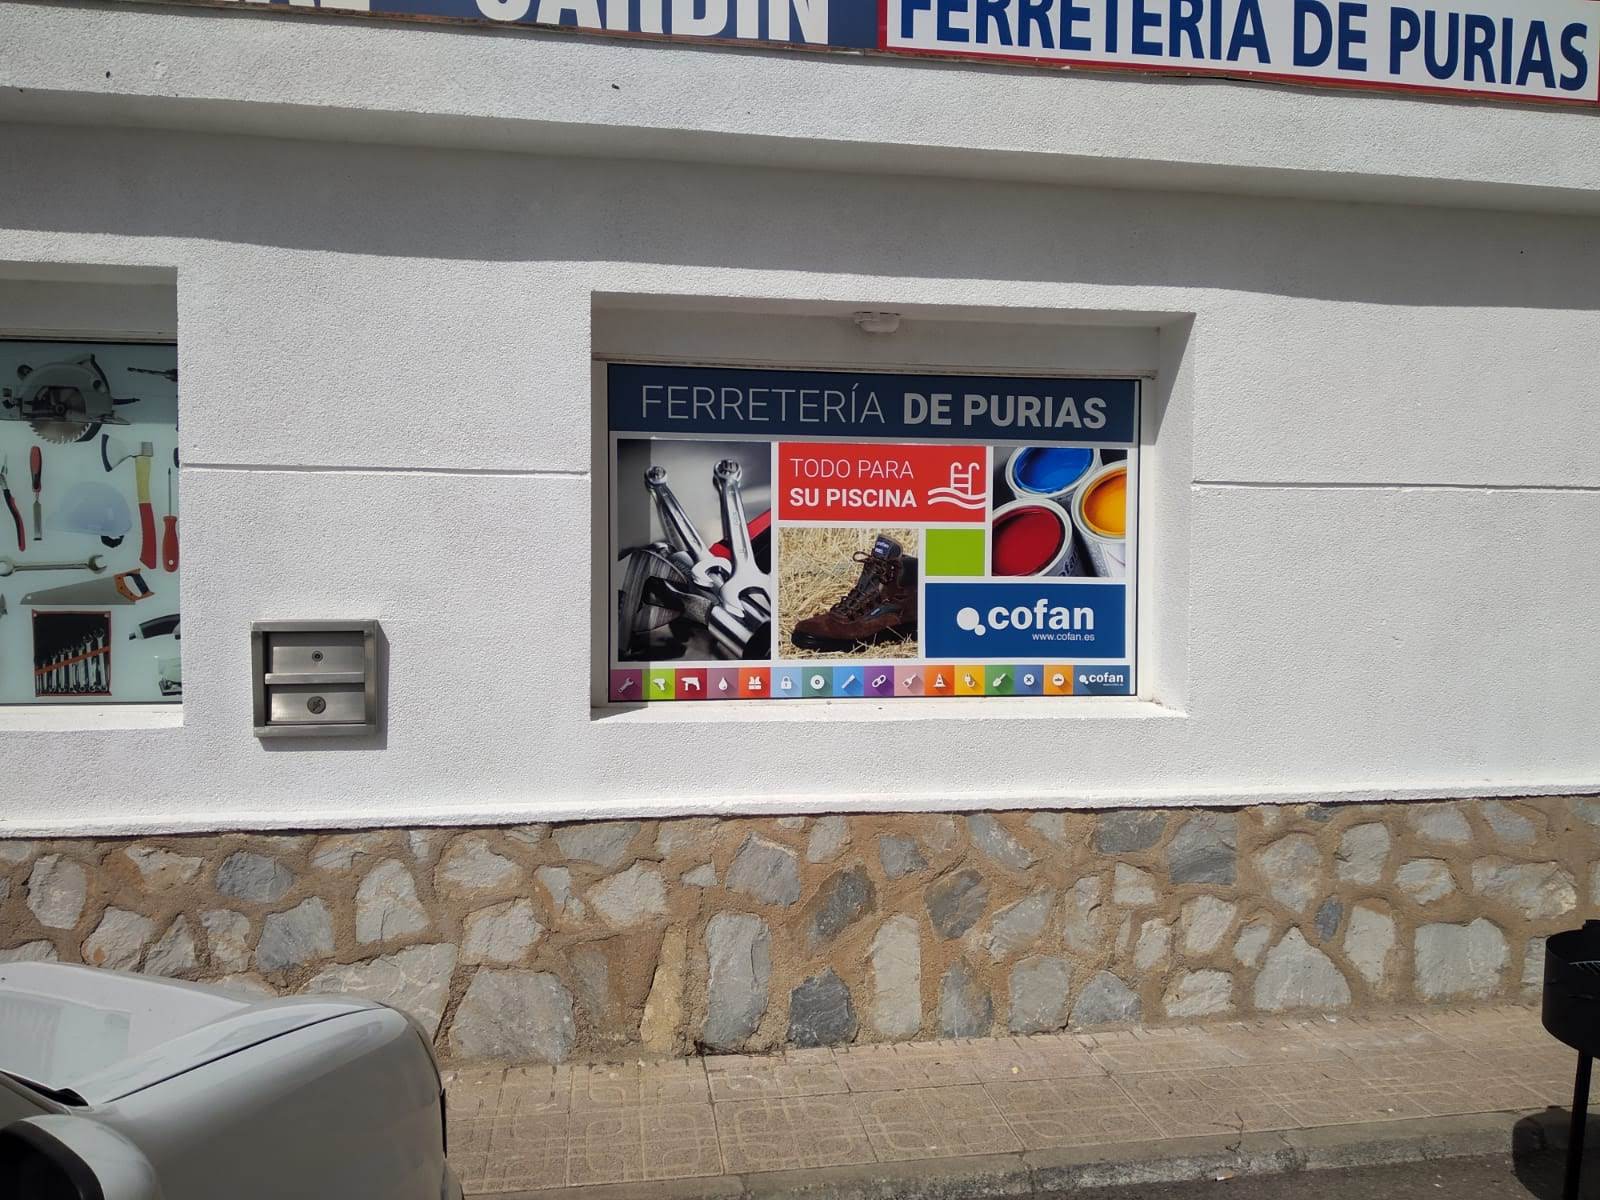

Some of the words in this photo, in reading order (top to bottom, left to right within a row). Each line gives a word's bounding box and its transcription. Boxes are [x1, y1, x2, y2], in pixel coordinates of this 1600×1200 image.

[1293, 0, 1367, 72] DE
[1389, 6, 1588, 92] PURIAS
[642, 382, 886, 424] FERRETERÍA
[903, 392, 952, 426] DE
[963, 394, 1107, 429] PURIAS
[790, 458, 851, 478] TODO
[858, 459, 914, 479] PARA
[790, 487, 819, 507] SU
[826, 488, 918, 508] PISCINA
[987, 598, 1095, 631] cofan
[1031, 631, 1096, 642] www.cofan.es
[1088, 671, 1124, 683] cofan
